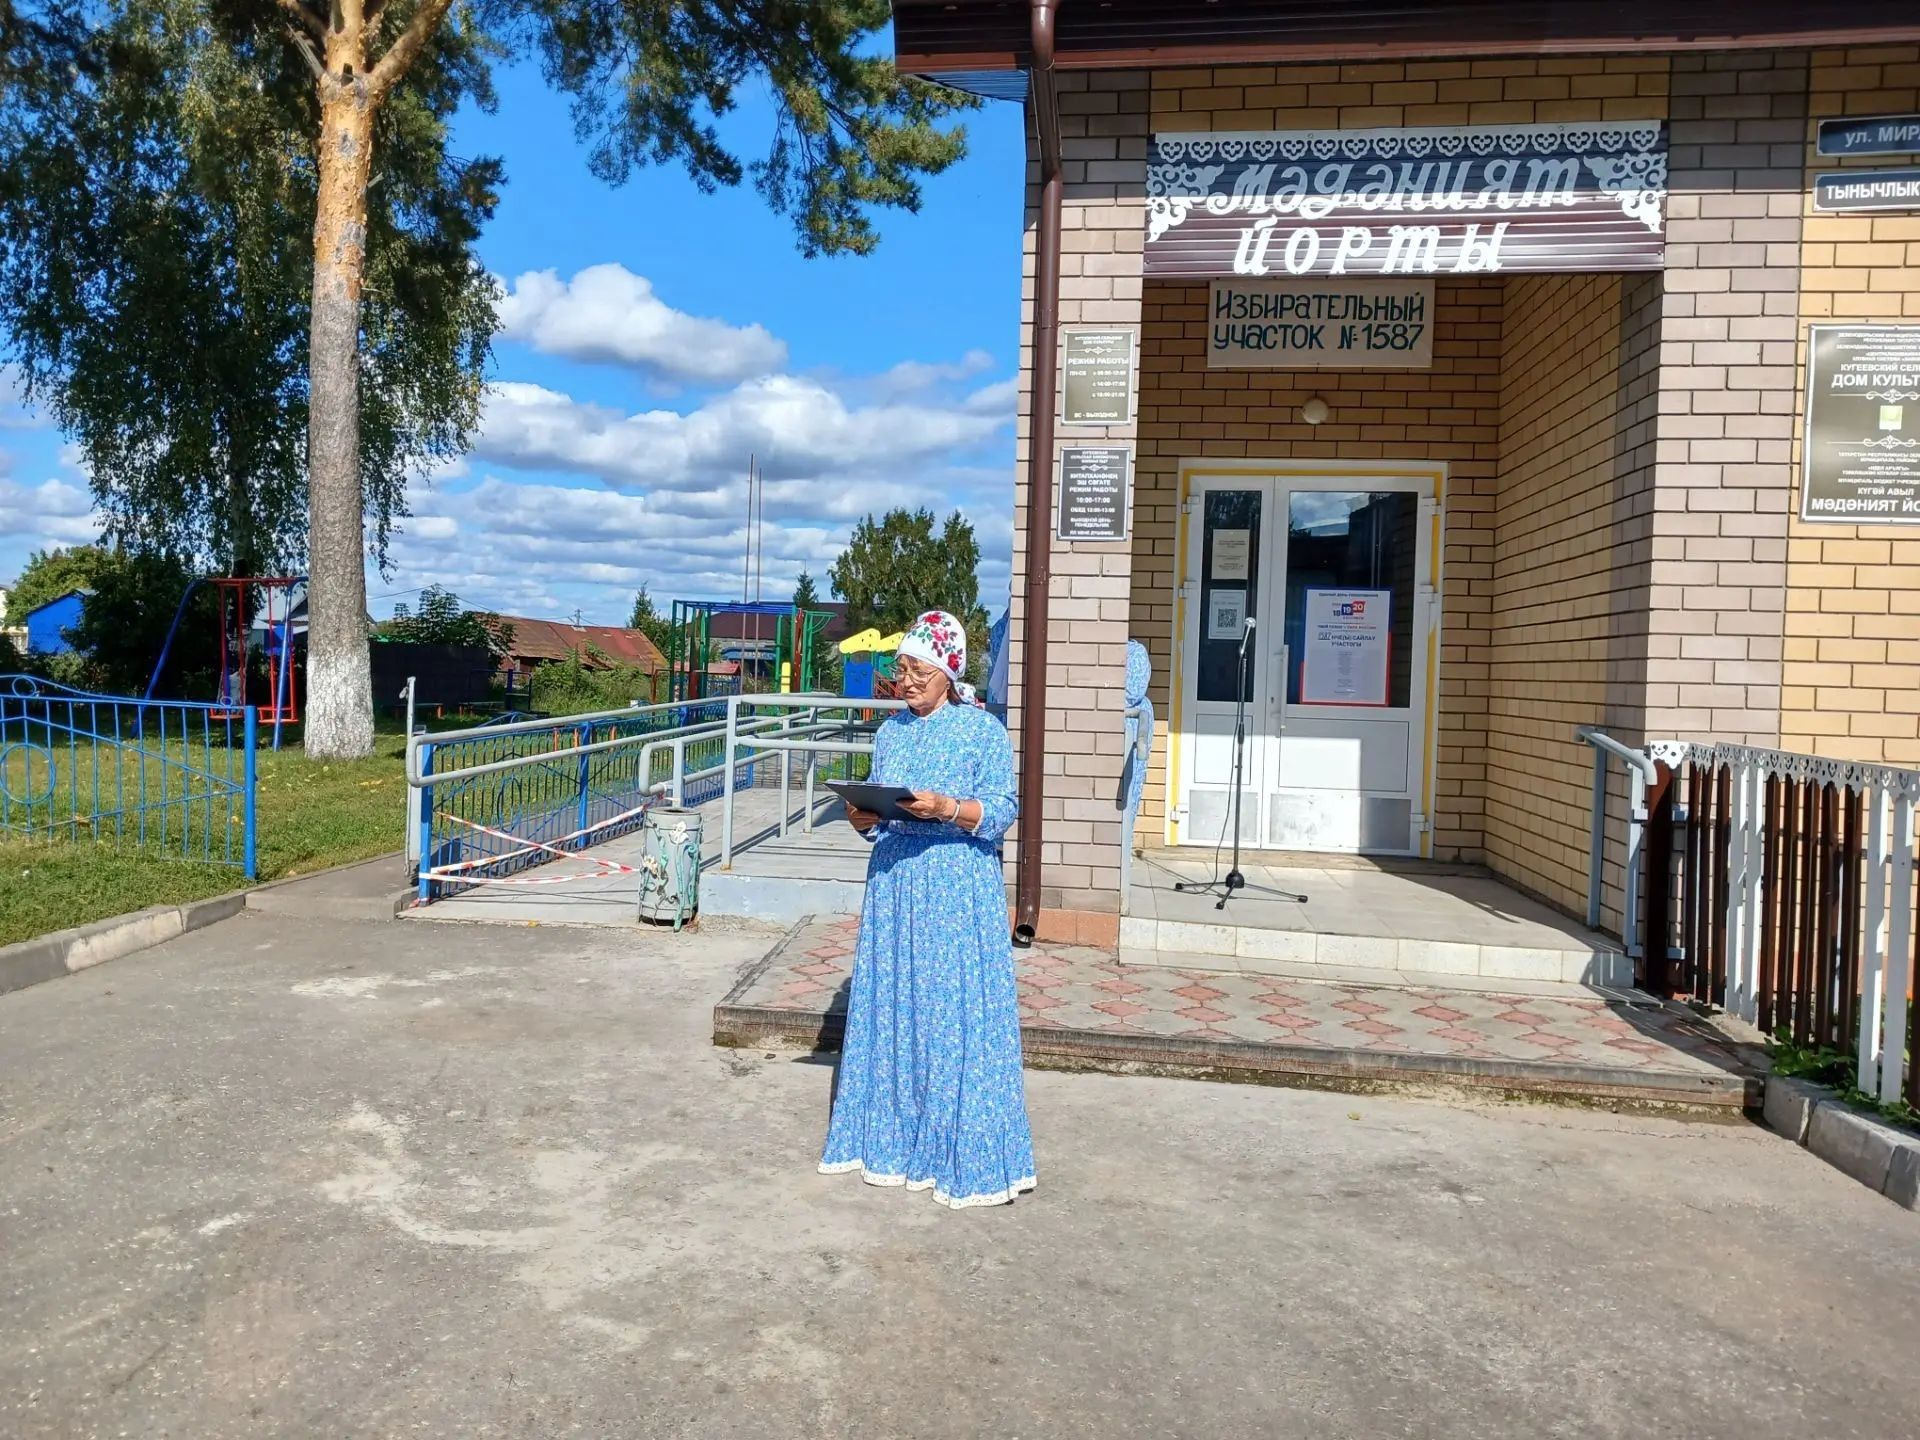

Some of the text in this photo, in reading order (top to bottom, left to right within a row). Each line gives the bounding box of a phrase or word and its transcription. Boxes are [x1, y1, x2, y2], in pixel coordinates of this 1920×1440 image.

[1844, 124, 1920, 148] ул. МИР
[1825, 180, 1920, 200] ТЫНЫЧЛЫК
[1214, 289, 1425, 322] ИЗБИРАТЕЛЬНЫЙ
[1213, 323, 1326, 351] УЧАСТОК
[1840, 362, 1898, 372] КУГЕЕВСКИЙ
[1831, 374, 1868, 388] ДОМ
[1886, 487, 1915, 496] АВЫЛ
[1811, 498, 1899, 512] МӘДӘНИЯТ
